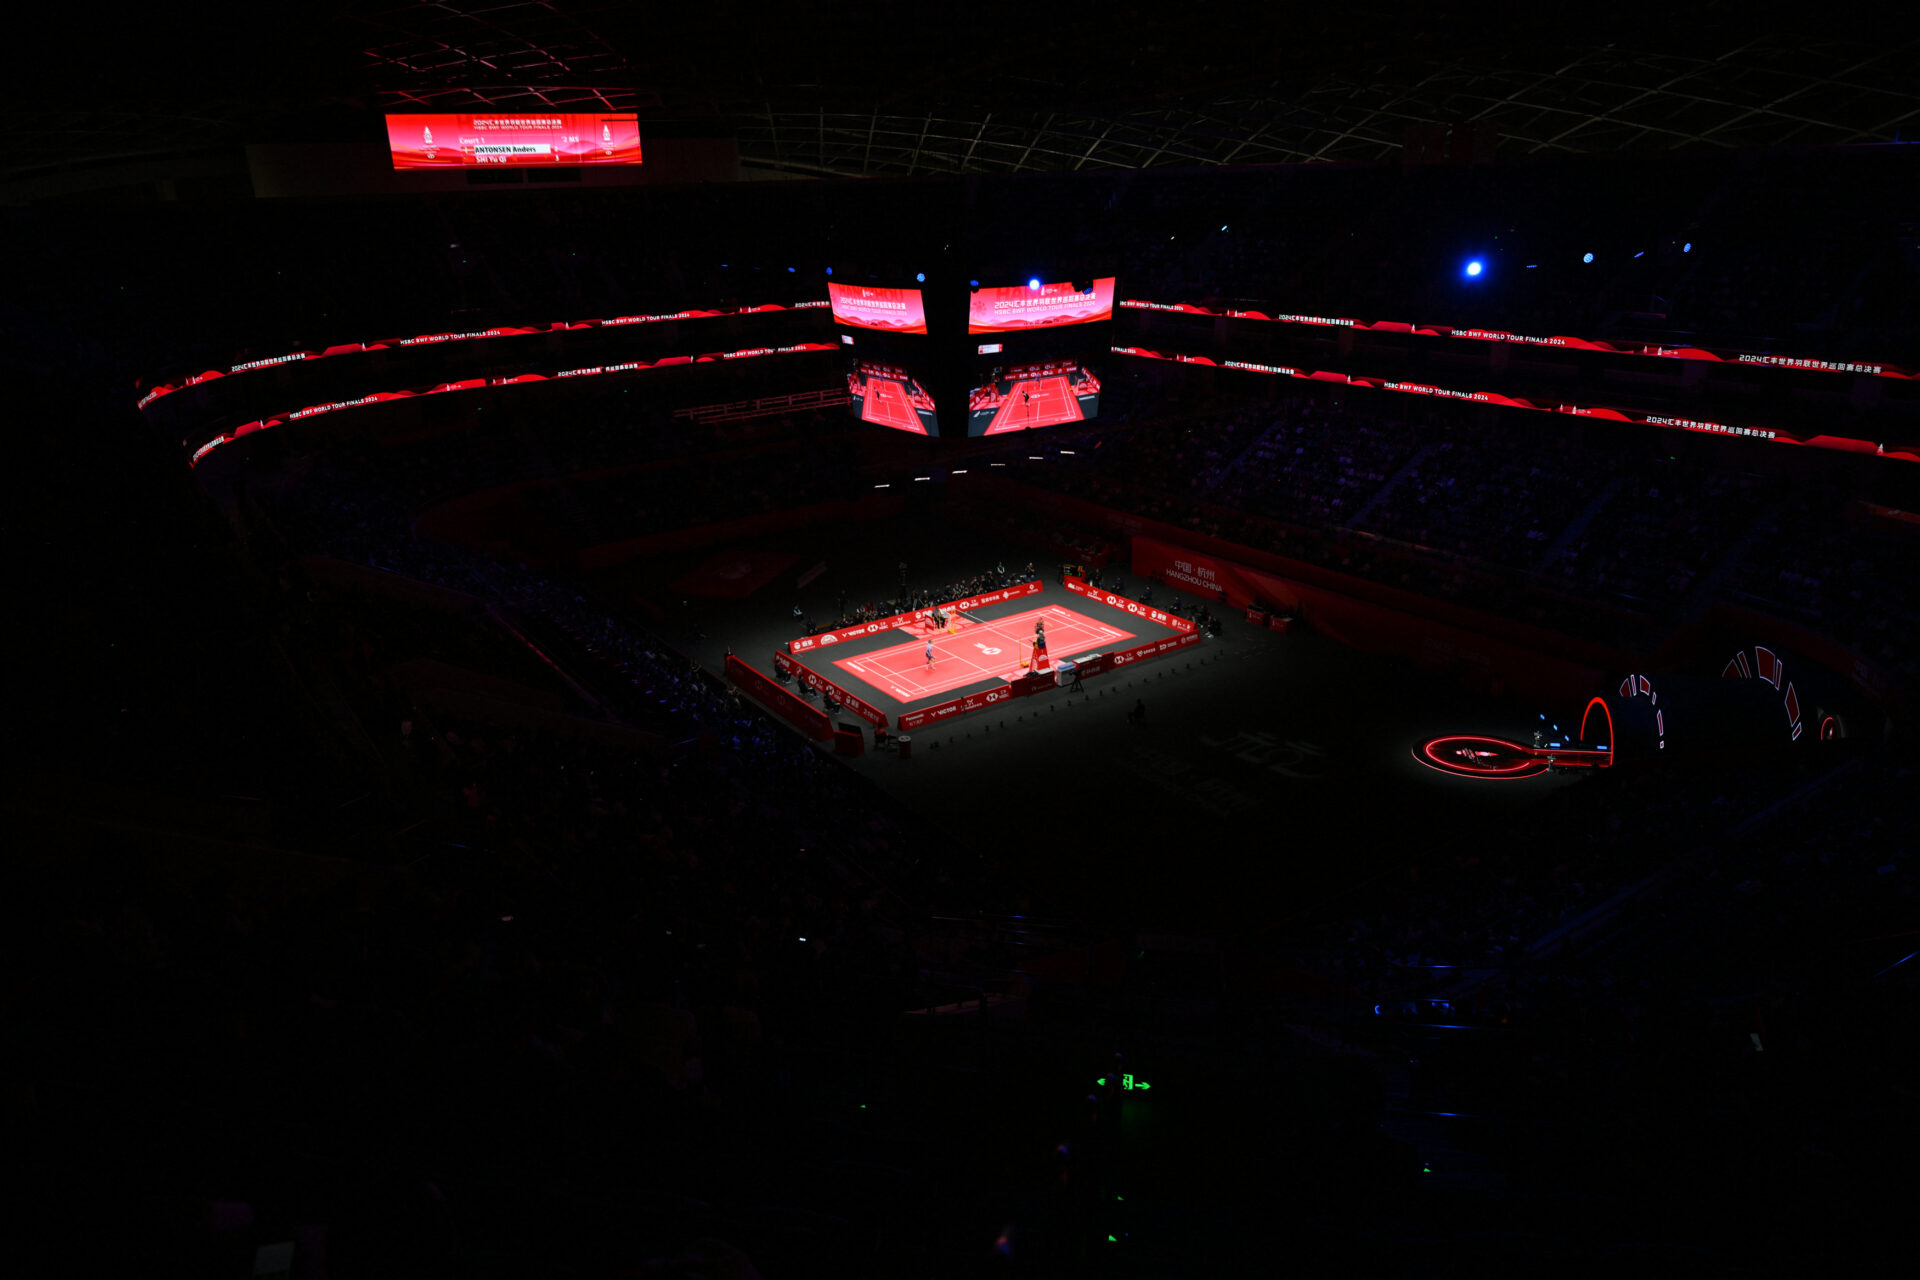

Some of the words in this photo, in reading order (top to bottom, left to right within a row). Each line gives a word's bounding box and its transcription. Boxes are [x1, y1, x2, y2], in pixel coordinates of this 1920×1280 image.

[430, 334, 450, 342] WORLD
[1452, 329, 1467, 337] HSBC
[1483, 332, 1506, 340] WORLD
[1506, 334, 1524, 342] TOUR
[1526, 336, 1548, 344] FINALS
[1384, 382, 1399, 390] HSBC
[1400, 383, 1412, 391] BWF
[1413, 385, 1434, 394] WORLD
[1435, 388, 1451, 397] TOUR
[1452, 390, 1473, 399] FINALS
[1474, 393, 1488, 401] 2024
[290, 410, 302, 419] HSBC
[302, 408, 313, 416] BWF
[314, 404, 332, 413] WORLD
[332, 400, 346, 409] TOUR
[346, 398, 365, 406] FINALS
[1166, 568, 1201, 586] HANGZHOU
[1203, 580, 1222, 592] CHINA
[937, 706, 957, 715] VICTOR
